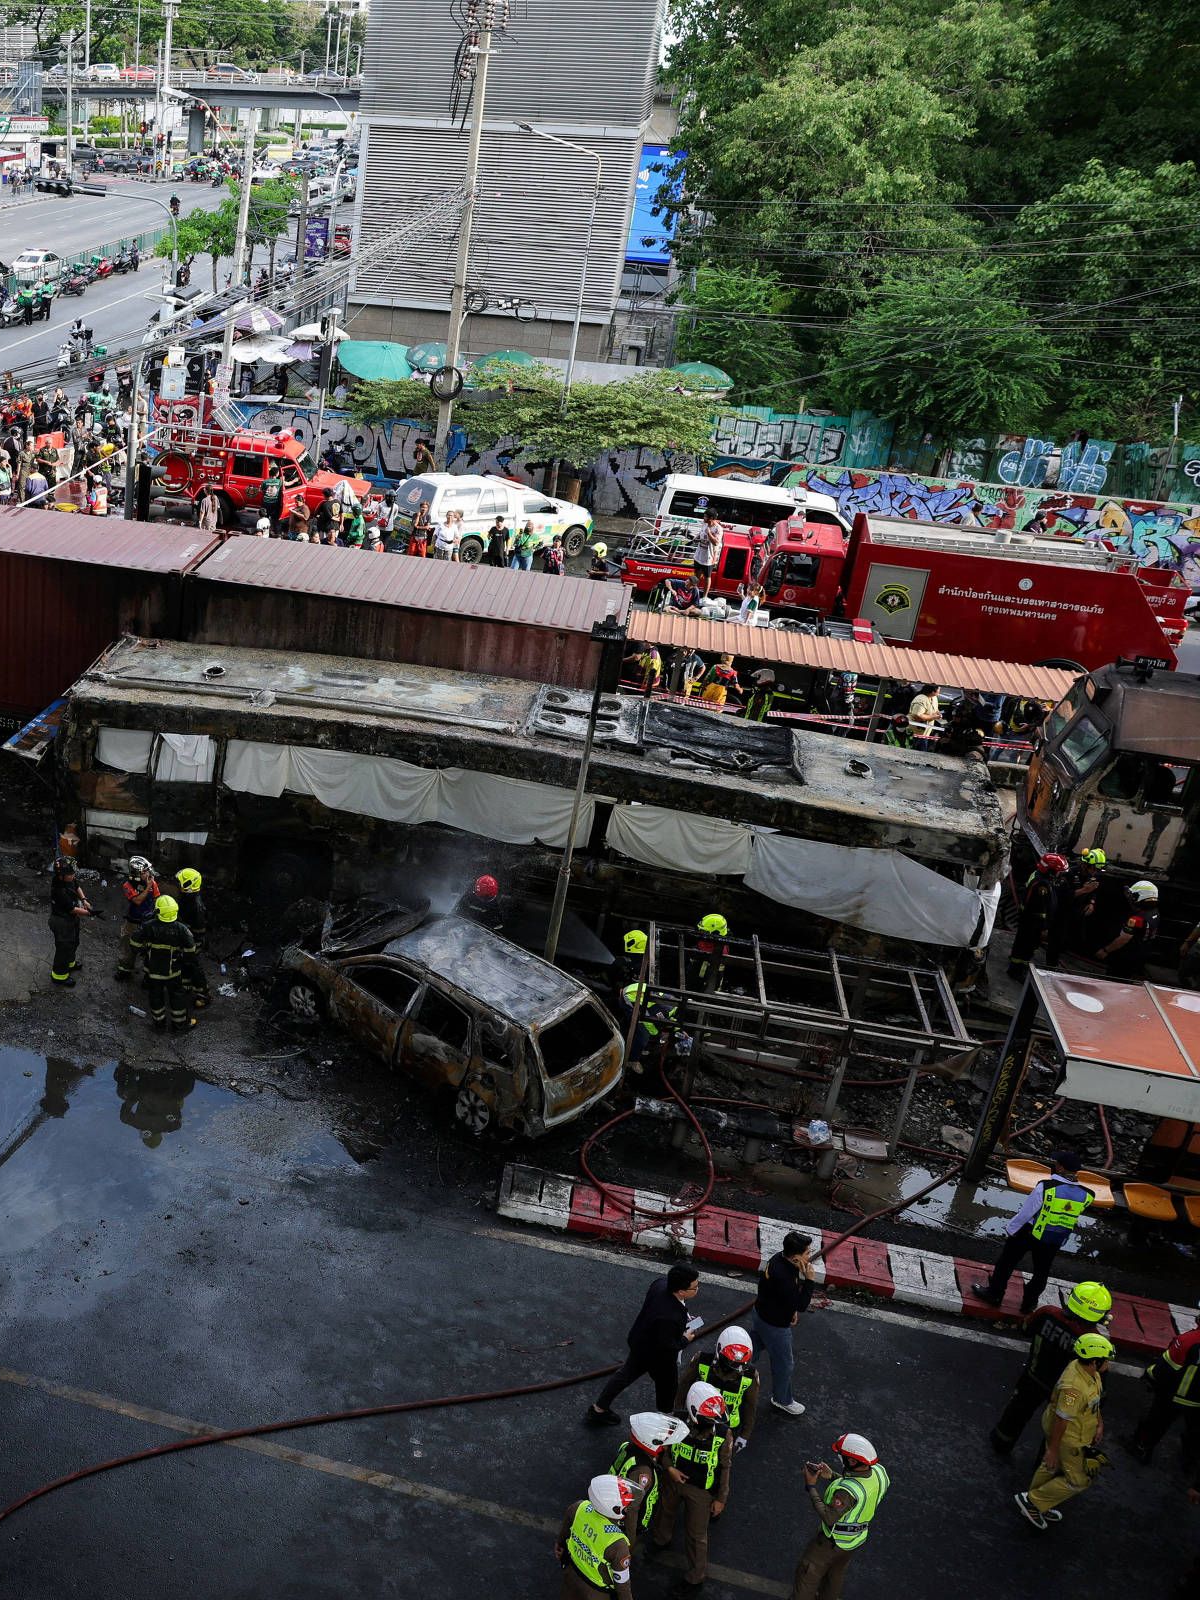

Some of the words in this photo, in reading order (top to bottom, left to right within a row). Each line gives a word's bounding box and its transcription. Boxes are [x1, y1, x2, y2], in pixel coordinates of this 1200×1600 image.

[981, 603, 1058, 621] กรุงเทพมหานคร
[583, 1522, 598, 1544] 191
